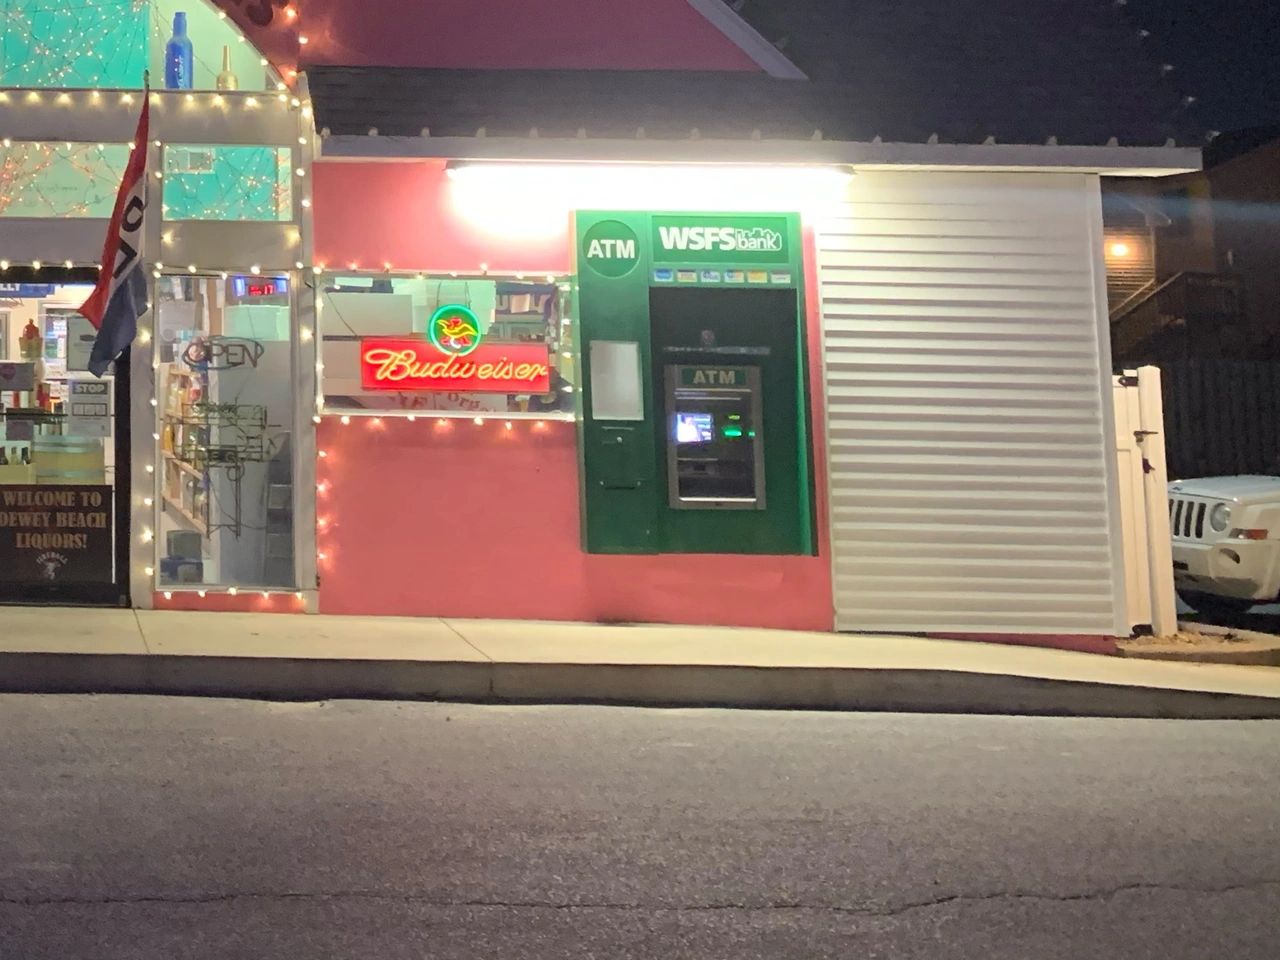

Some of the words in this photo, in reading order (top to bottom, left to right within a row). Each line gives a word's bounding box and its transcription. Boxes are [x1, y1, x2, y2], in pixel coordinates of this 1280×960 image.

[658, 226, 736, 251] WSFS
[737, 232, 776, 250] bank
[587, 239, 635, 259] ATM
[365, 349, 548, 381] Budweiser
[693, 370, 736, 385] ATM
[74, 383, 105, 393] STOP
[3, 490, 76, 507] WELCOME
[80, 491, 102, 507] TO
[56, 511, 107, 528] BEACH
[15, 533, 88, 550] LIQUORS!
